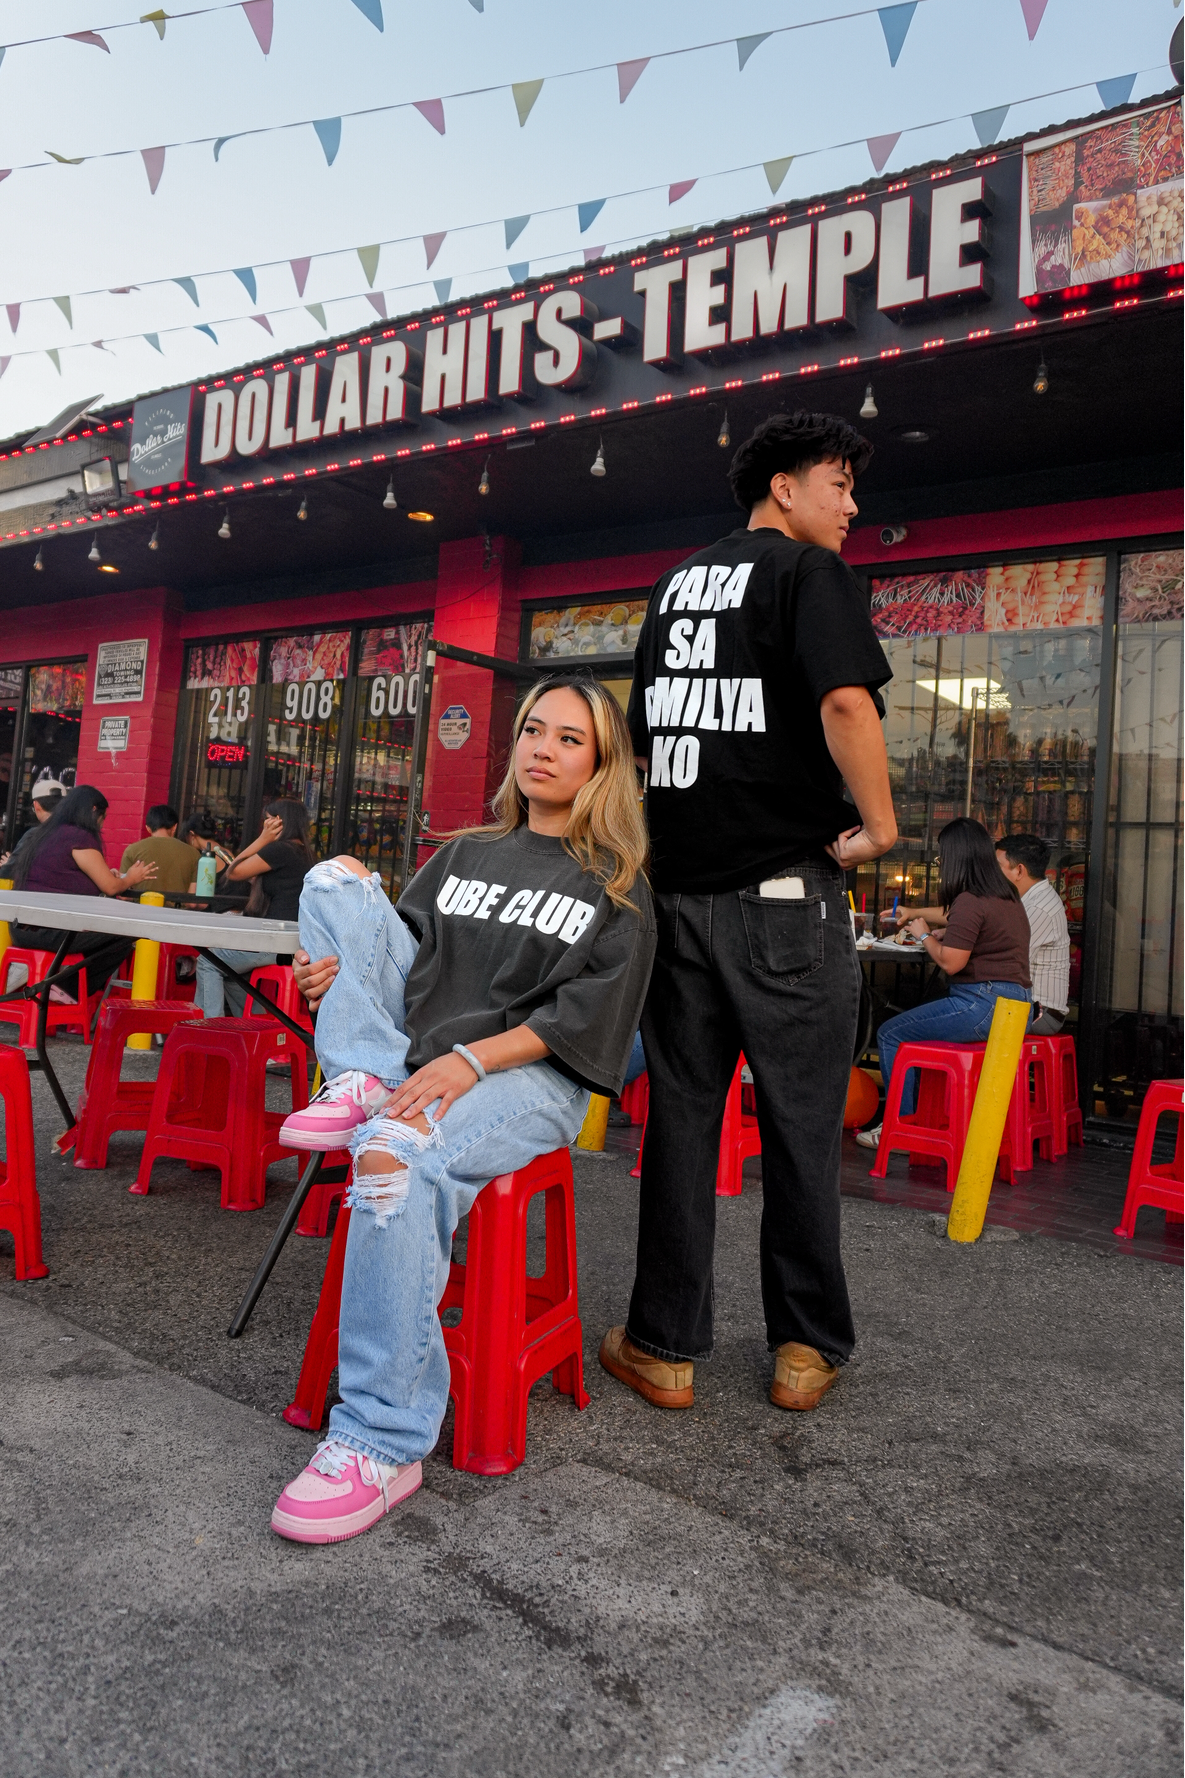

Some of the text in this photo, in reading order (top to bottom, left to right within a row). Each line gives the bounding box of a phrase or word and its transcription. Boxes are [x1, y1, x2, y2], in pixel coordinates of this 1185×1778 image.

[200, 339, 409, 466] DOLLAR
[420, 289, 584, 414] HITS
[633, 175, 985, 366] TEMPLE
[131, 422, 186, 461] Dollar Hits
[659, 562, 754, 615] PARA
[664, 617, 717, 670] SA
[100, 677, 113, 685] (323)
[107, 661, 142, 673] DIAMOND
[208, 686, 251, 724] 213
[284, 680, 334, 721] 908
[101, 728, 126, 736] PROPERTY
[104, 720, 125, 728] PRIVATE
[207, 743, 245, 763] OPEN
[650, 735, 701, 789] KO
[436, 874, 596, 945] UBE CLUB
